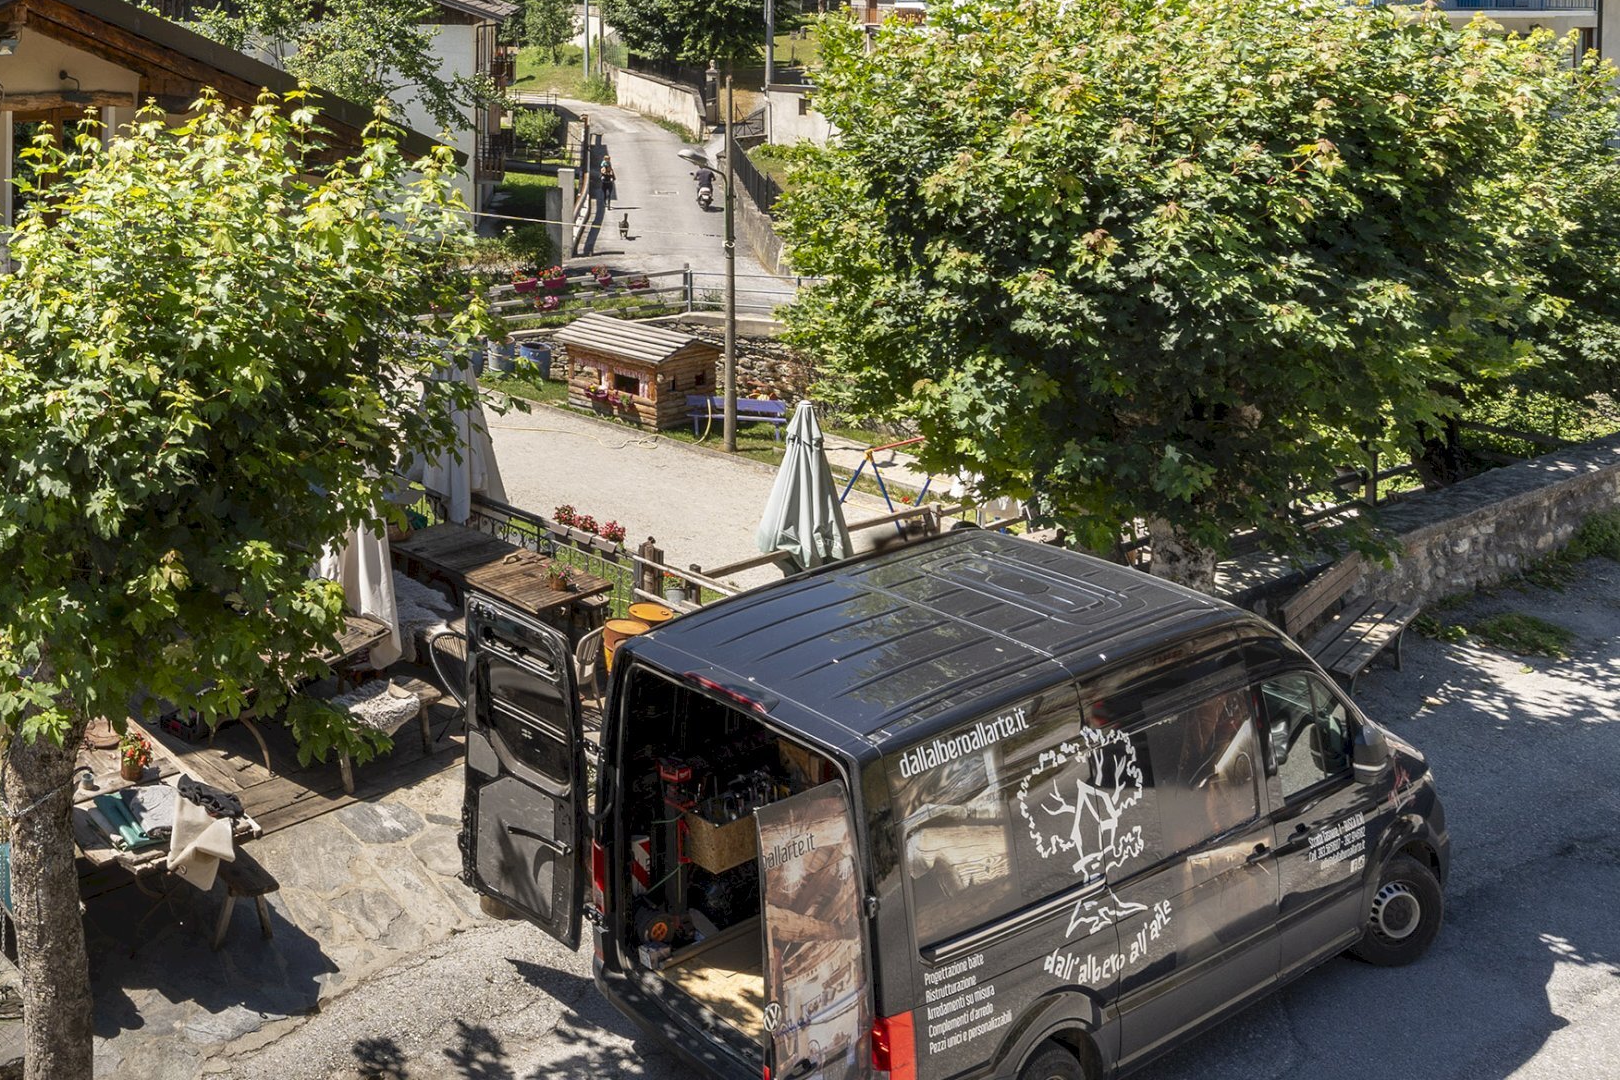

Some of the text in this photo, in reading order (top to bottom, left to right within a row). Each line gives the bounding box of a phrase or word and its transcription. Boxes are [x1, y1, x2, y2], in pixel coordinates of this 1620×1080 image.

[899, 707, 1030, 778] dallalberoallarte.it
[1043, 899, 1173, 985] dall'albero all'arte
[924, 953, 985, 986] Progettazione baite
[925, 975, 977, 1003] Ristrutturazione
[927, 994, 966, 1021] Arredamenti
[974, 984, 996, 1001] misura
[928, 1010, 970, 1038] Complementi
[929, 1037, 947, 1055] Pezzi
[947, 1032, 963, 1048] unici
